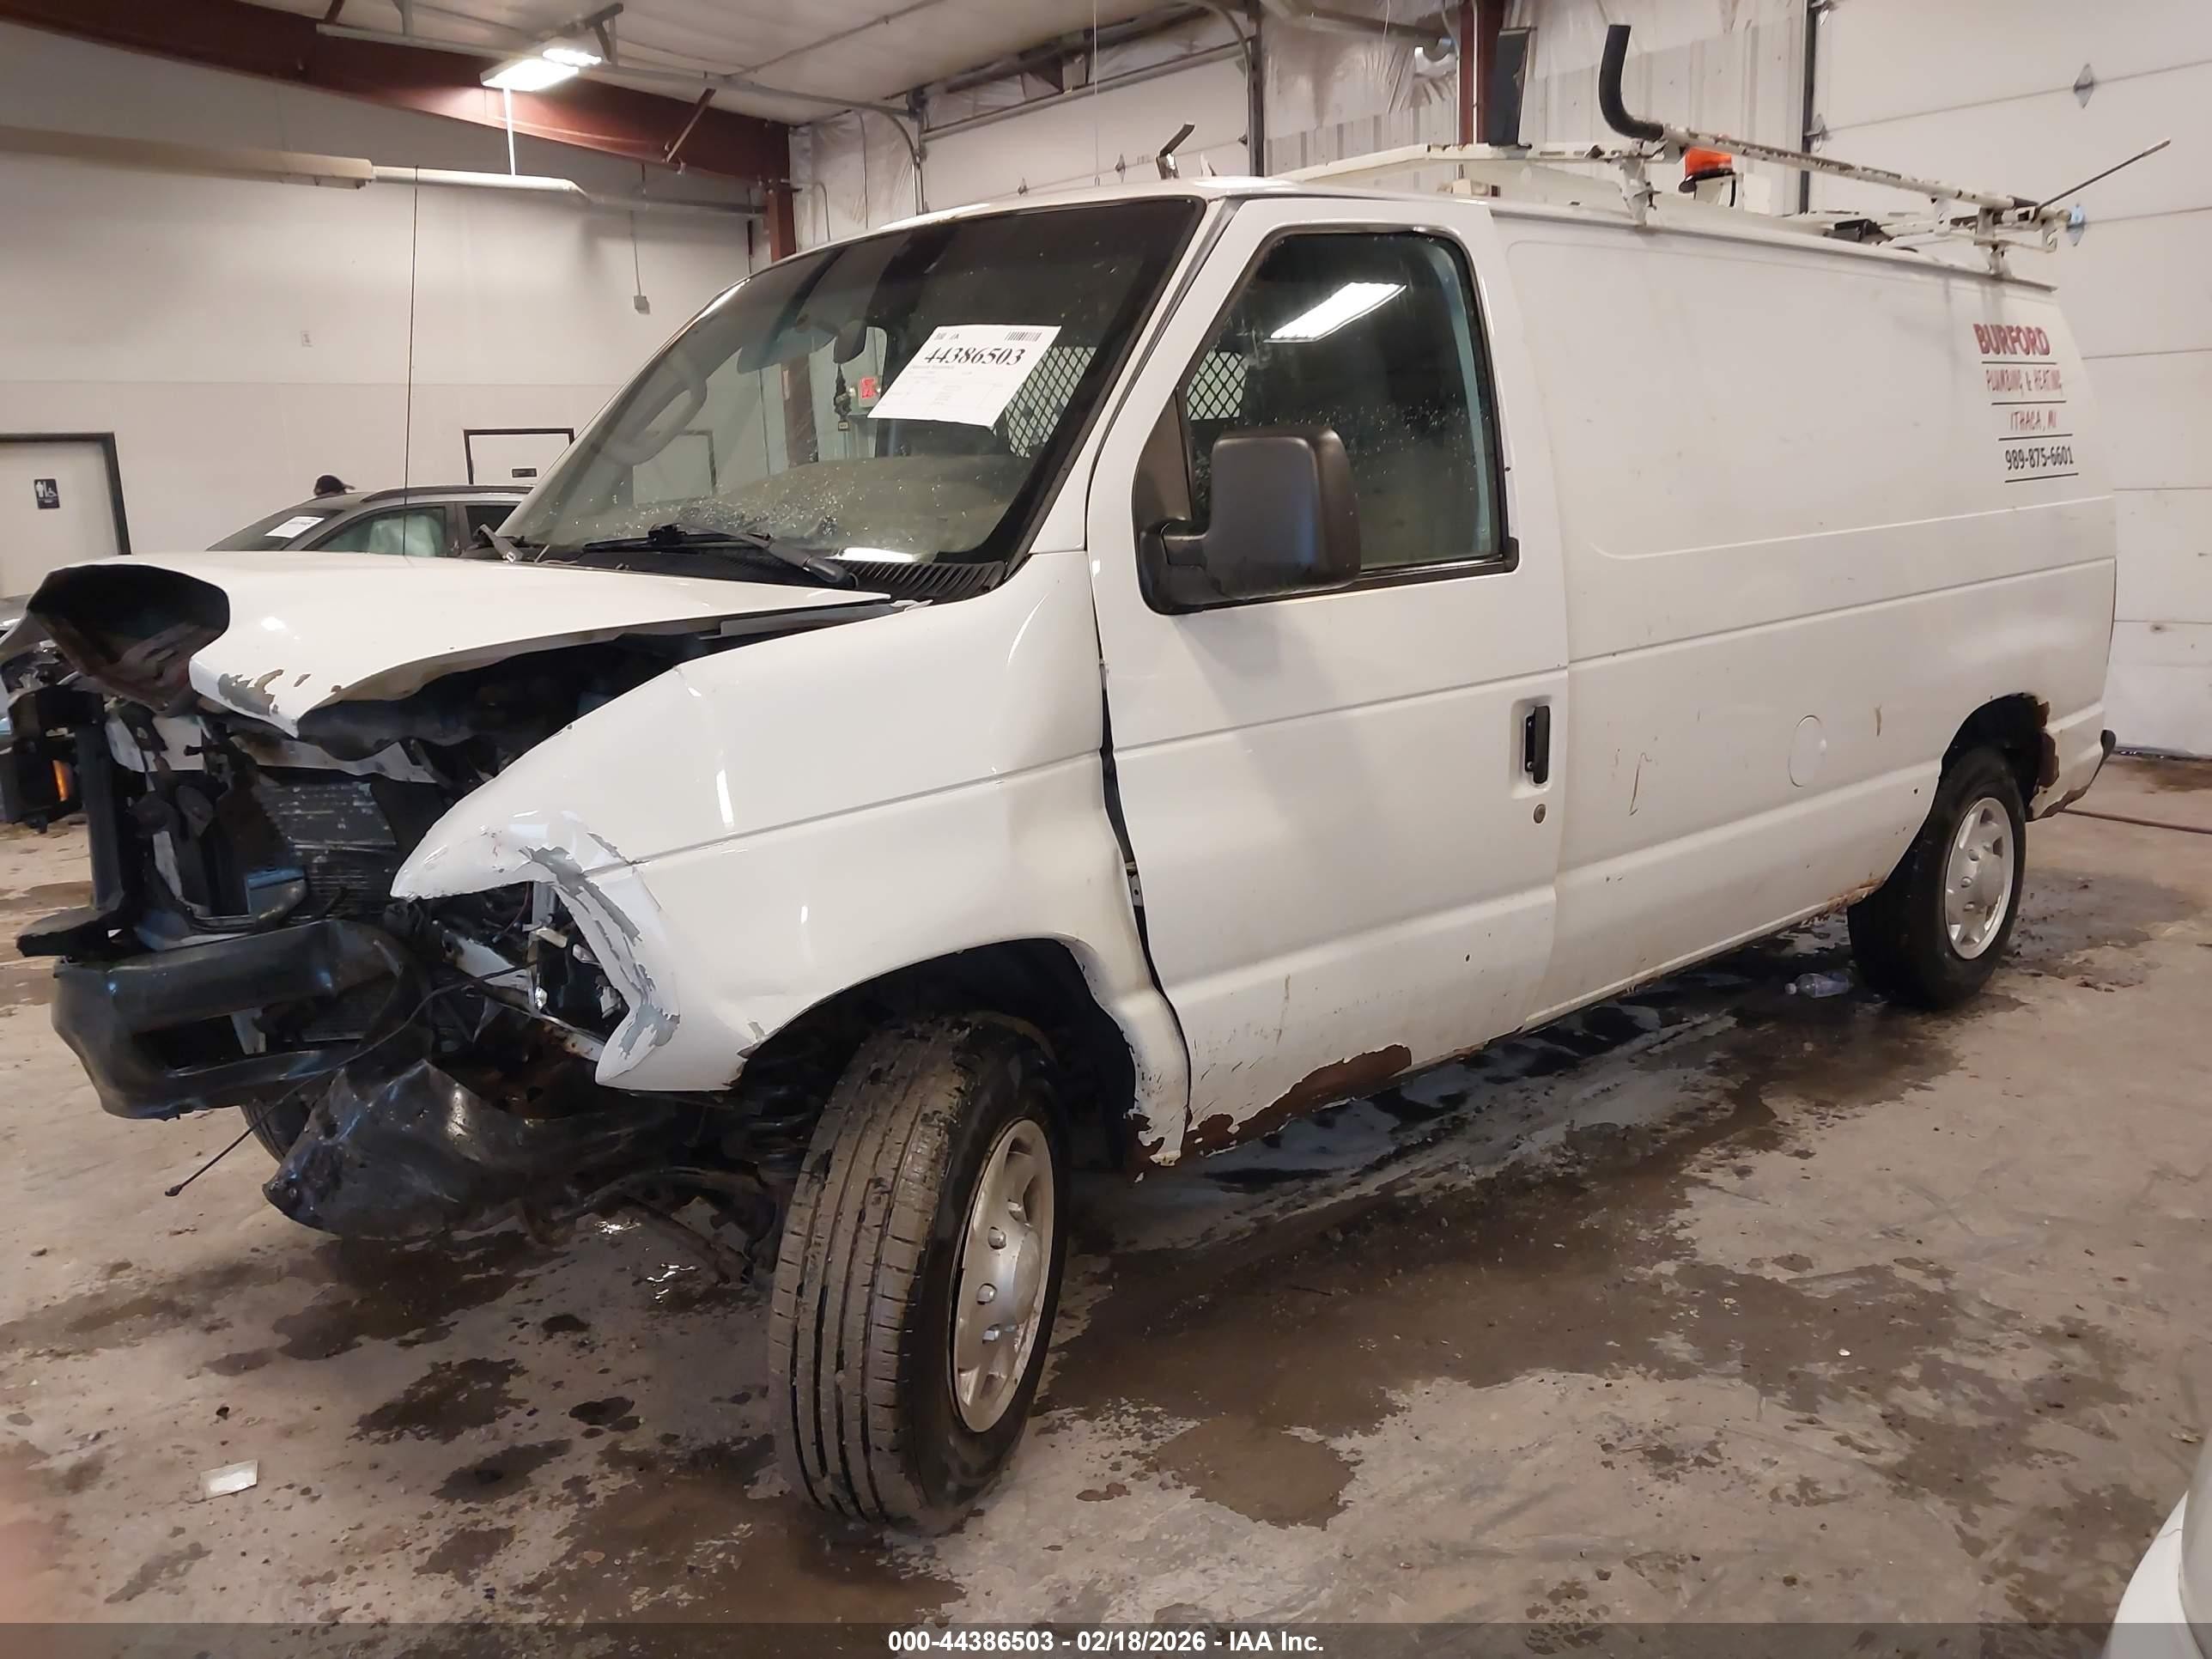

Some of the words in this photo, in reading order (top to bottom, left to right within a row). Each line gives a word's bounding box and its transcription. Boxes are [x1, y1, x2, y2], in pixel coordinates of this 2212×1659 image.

[1972, 323, 2051, 356] BURFORD
[924, 346, 1026, 366] 44386503
[2004, 446, 2075, 471] 989-875-6601
